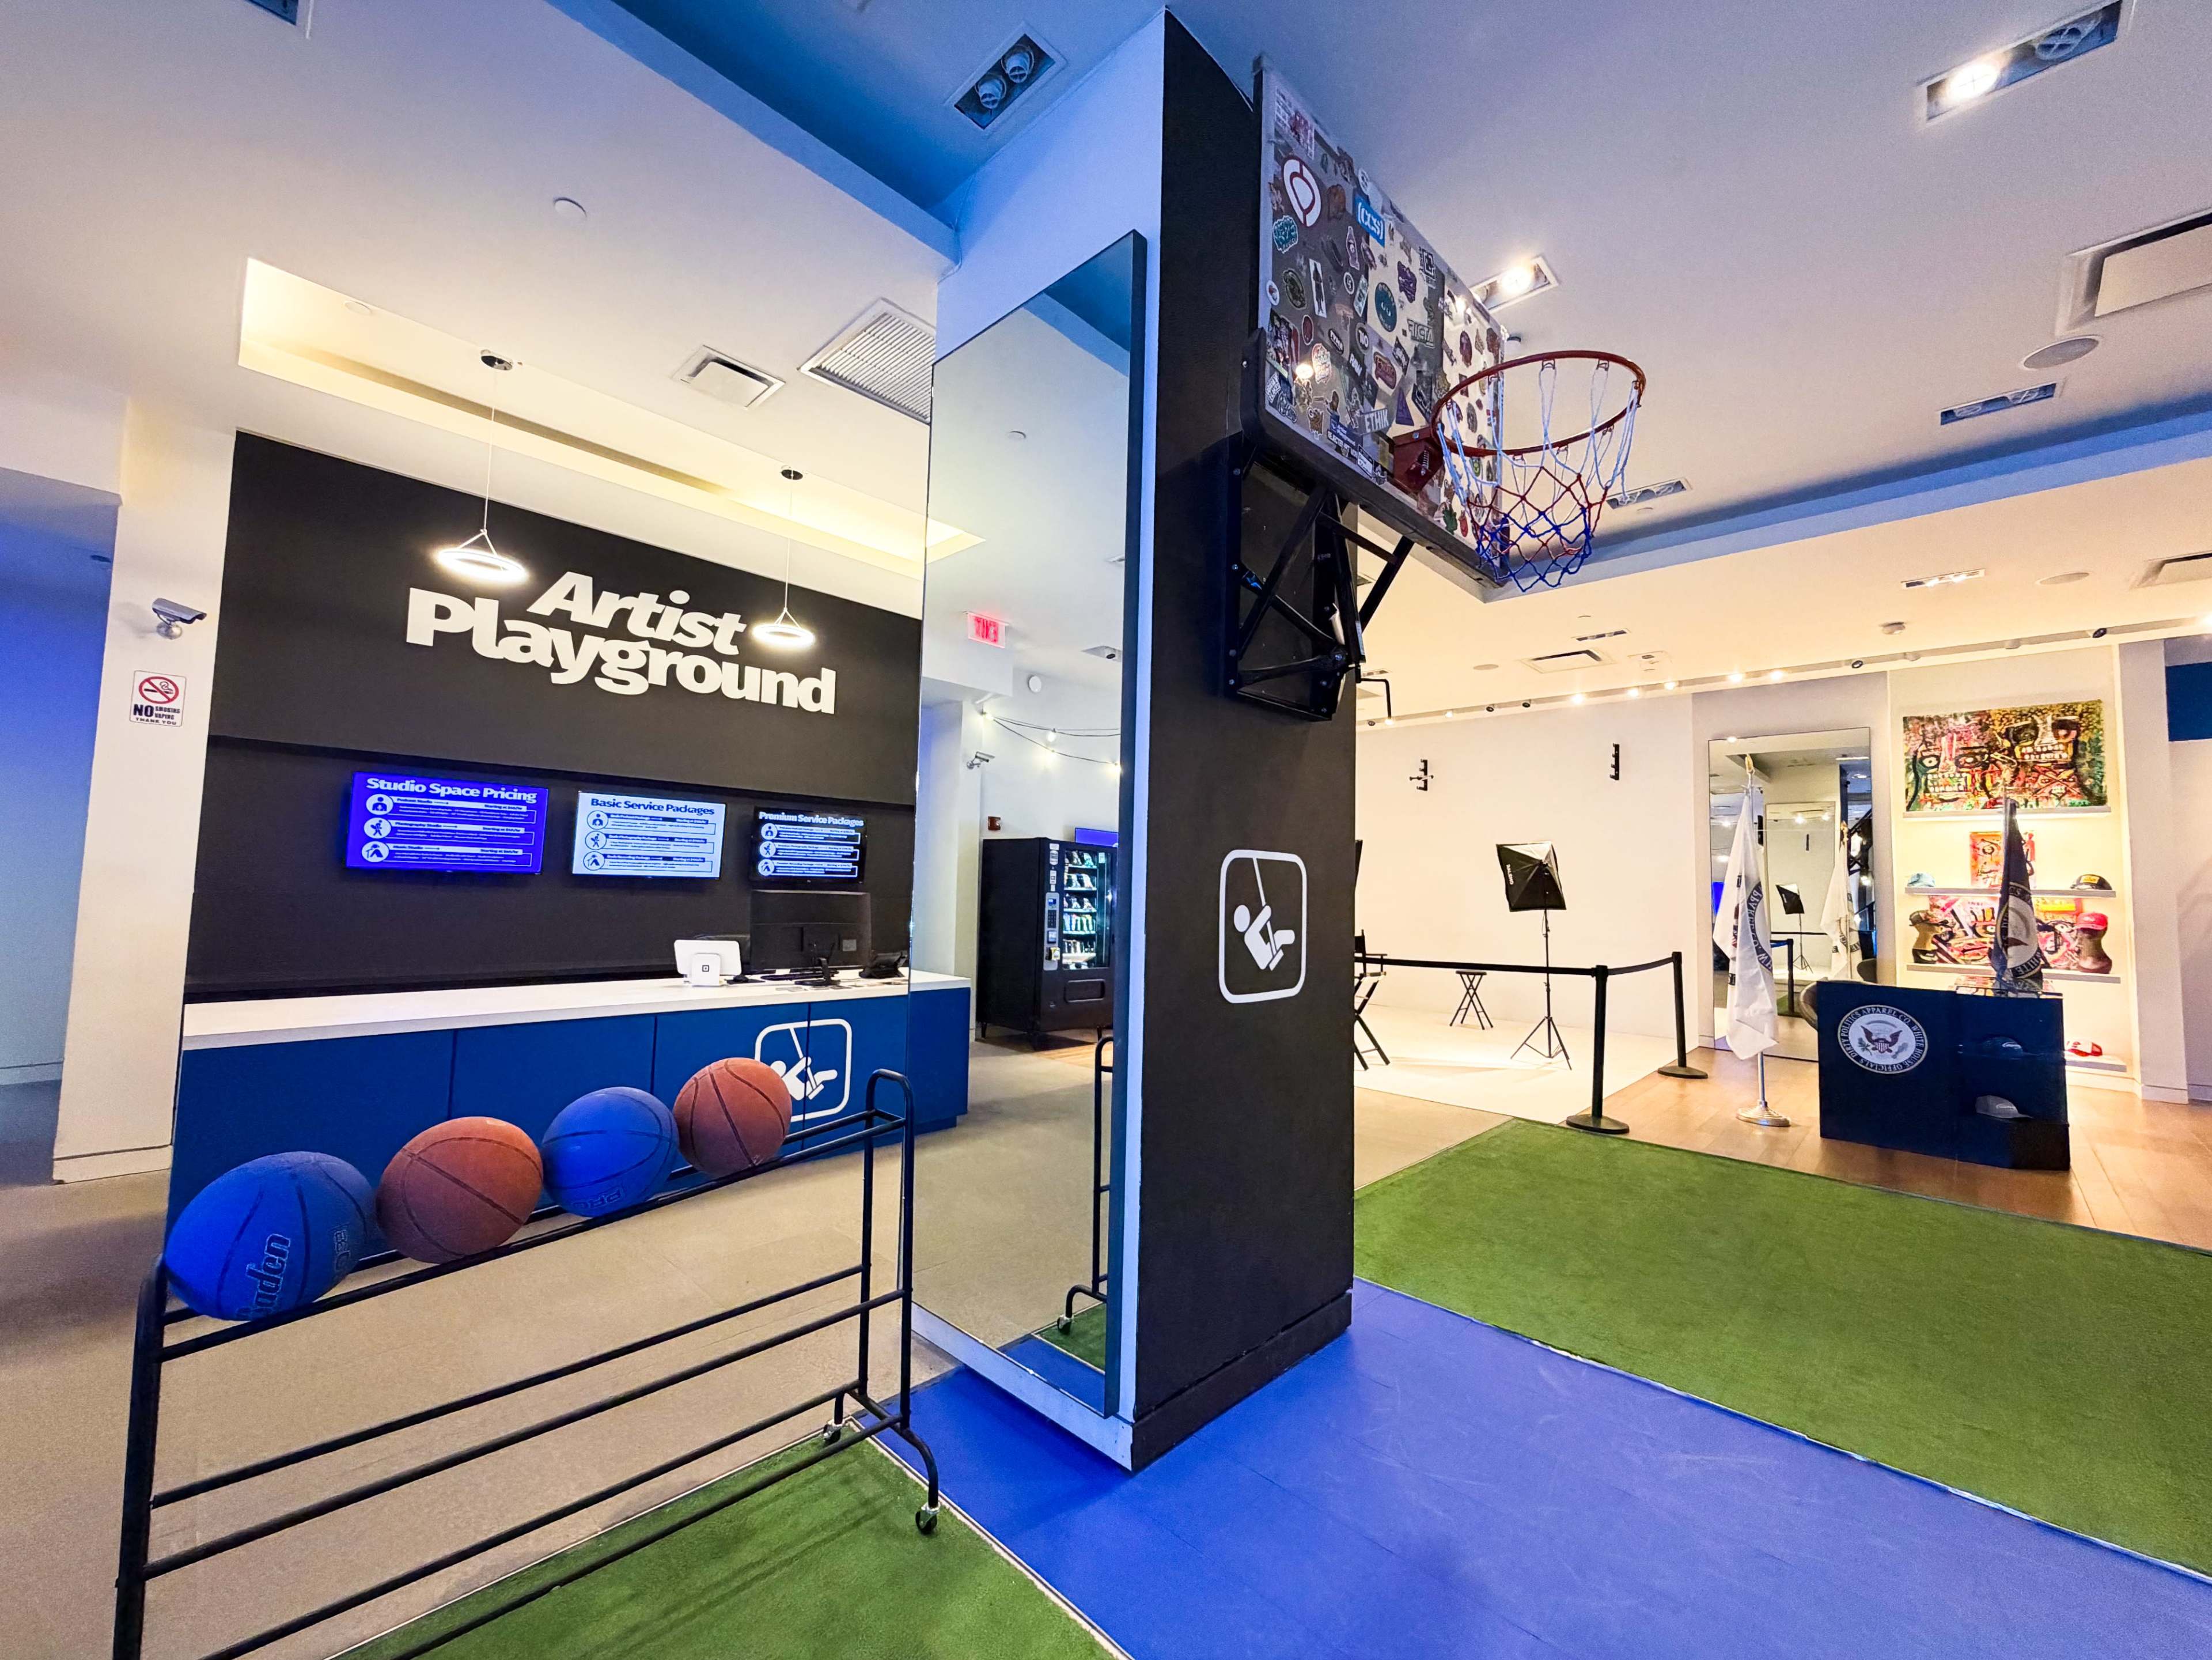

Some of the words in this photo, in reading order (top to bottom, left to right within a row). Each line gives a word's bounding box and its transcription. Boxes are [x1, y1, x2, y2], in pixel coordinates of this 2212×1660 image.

[1364, 408, 1389, 432] ETHIK
[527, 571, 747, 655] Artist
[406, 587, 835, 714] Playground
[133, 704, 154, 717] NO
[366, 777, 427, 793] Studio
[429, 782, 480, 797] Space
[483, 787, 537, 804] Pricing
[591, 798, 623, 808] Basic
[623, 800, 664, 811] Service
[665, 803, 715, 815] Packages
[759, 811, 797, 822] Premium
[797, 814, 827, 824] Service
[828, 816, 864, 827] Packages
[1861, 1007, 1897, 1018] APPAREL
[1840, 1011, 1862, 1037] POLITICS
[1911, 1024, 1925, 1048] WHITE
[1841, 1038, 1858, 1058] DIRTY
[1903, 1047, 1924, 1066] HOUSE
[1858, 1058, 1903, 1072] OFFICIALS
